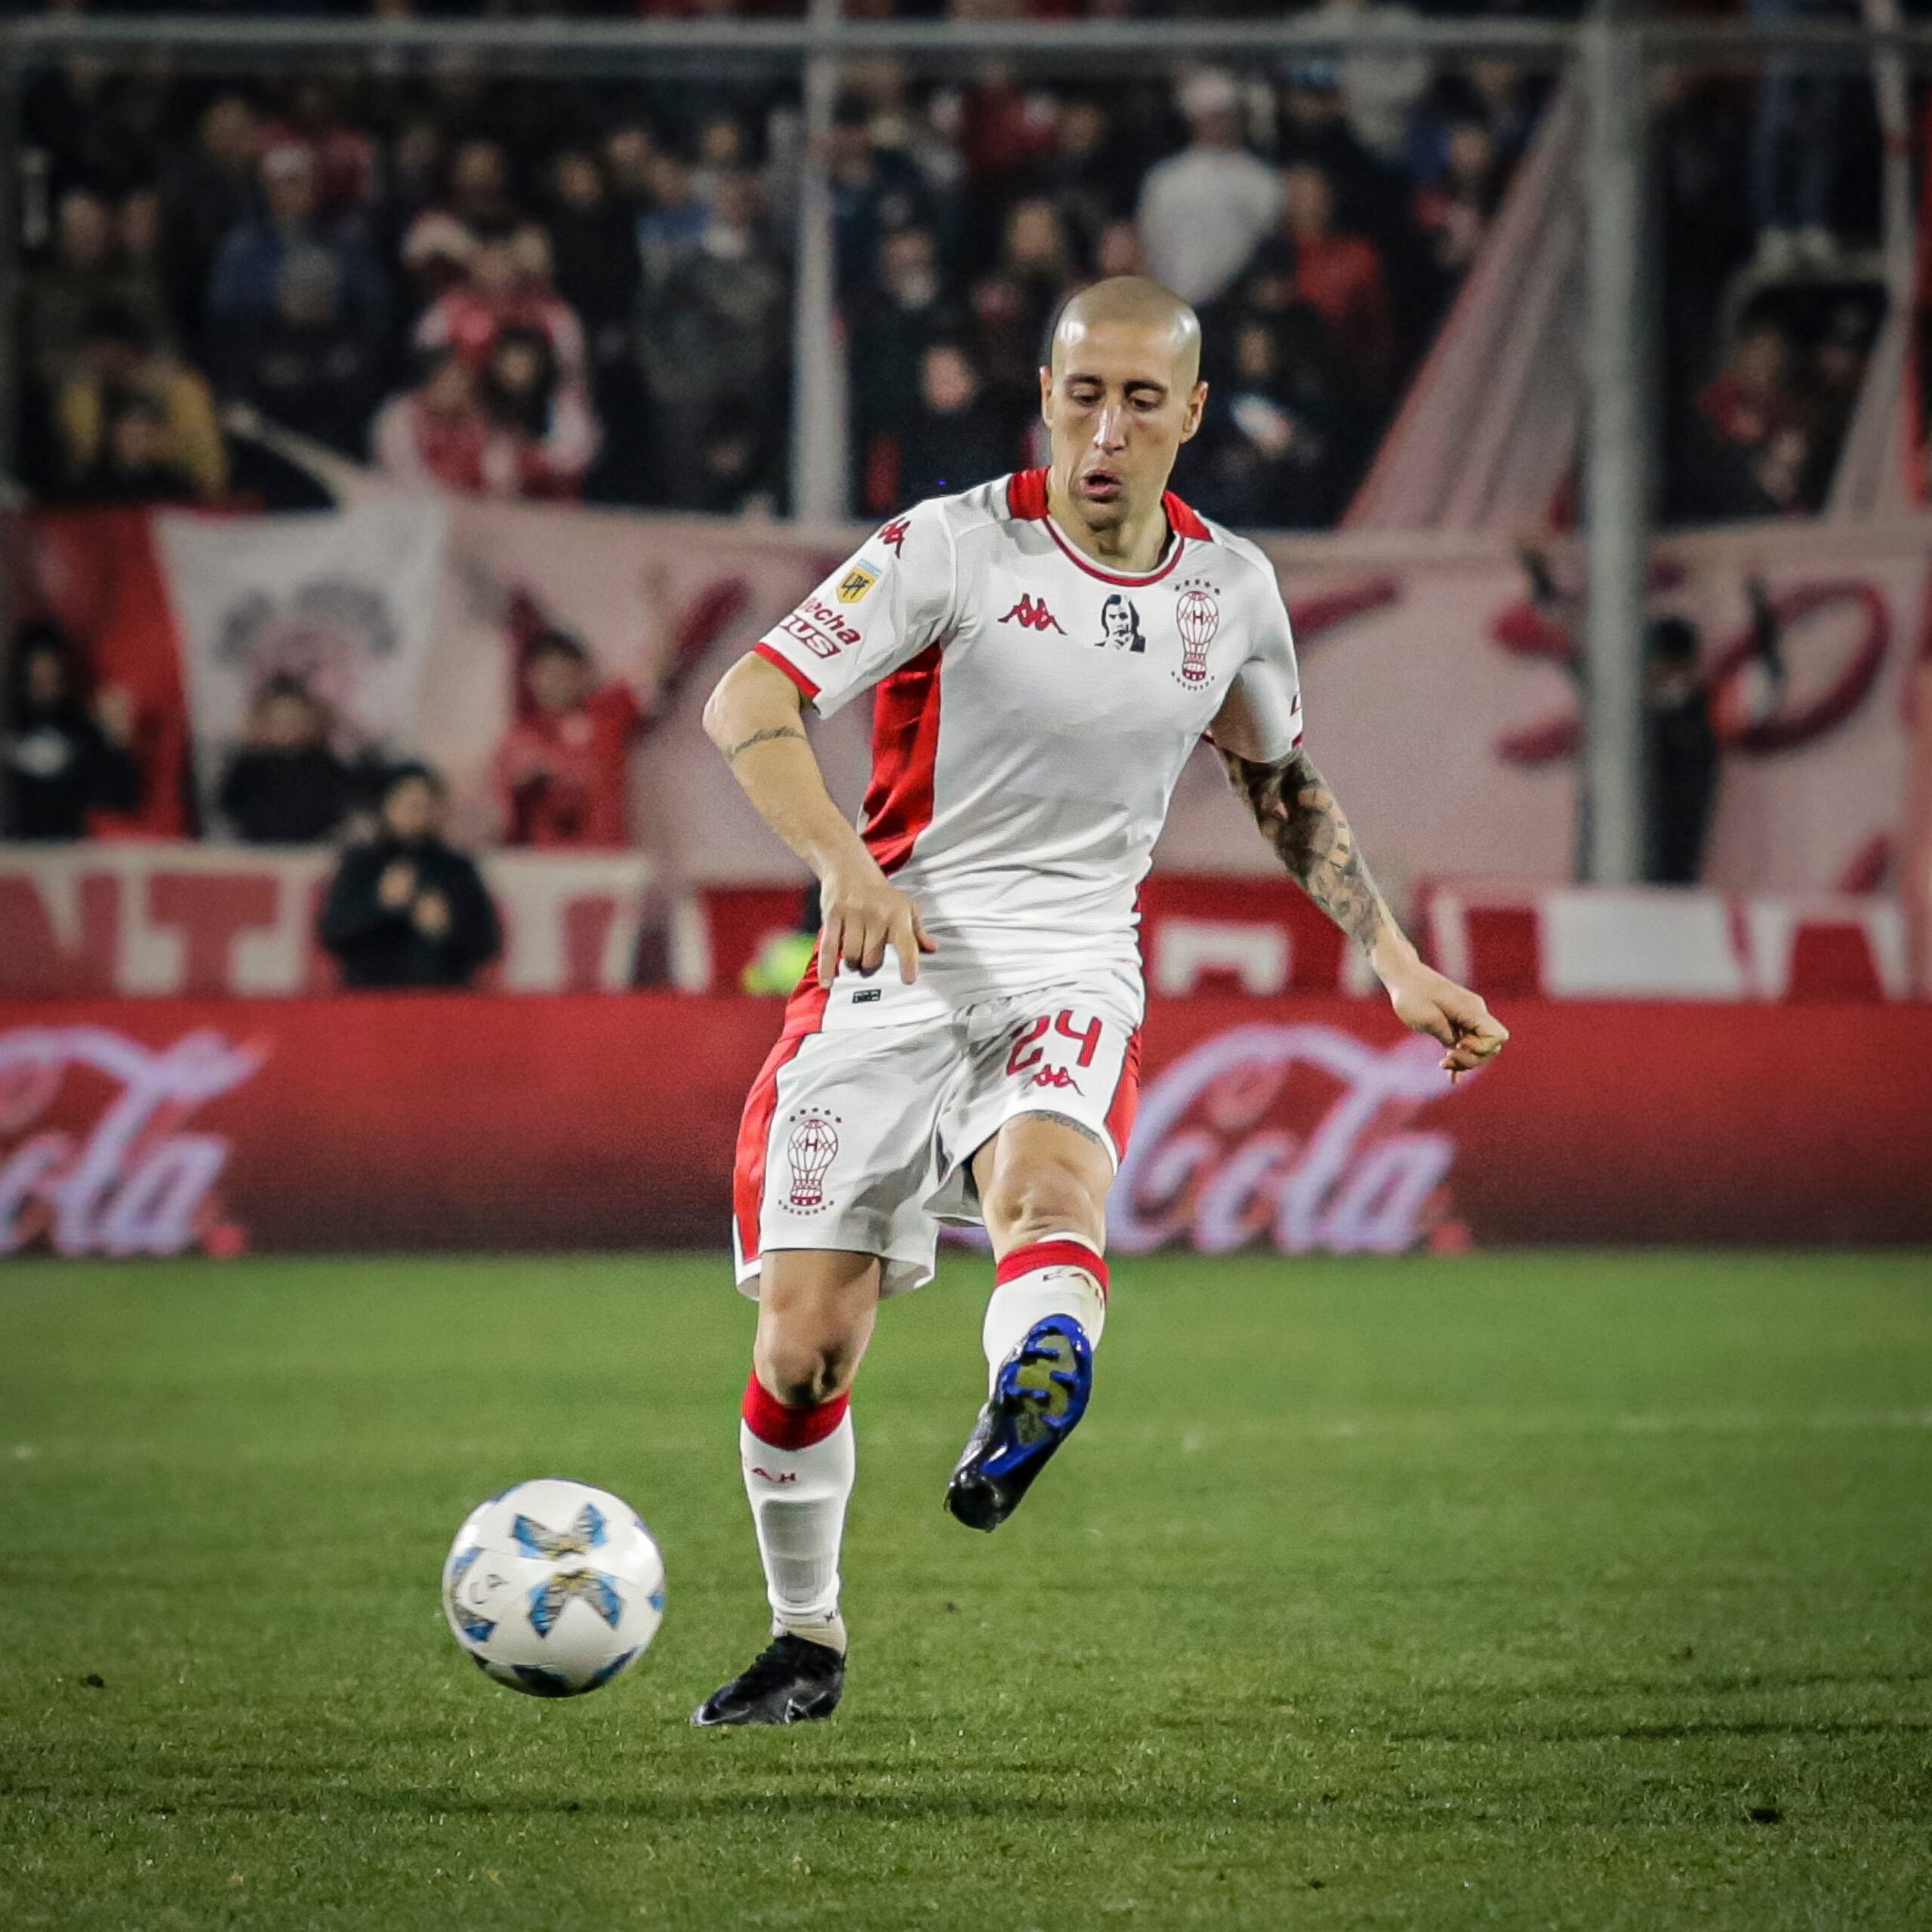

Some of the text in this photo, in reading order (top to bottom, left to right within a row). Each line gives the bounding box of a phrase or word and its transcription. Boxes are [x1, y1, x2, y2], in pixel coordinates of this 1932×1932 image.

[780, 613, 842, 659] US
[1193, 610, 1203, 625] H
[1006, 1009, 1103, 1076] 24
[805, 1139, 818, 1152] H
[1105, 1024, 1481, 1255] Cola
